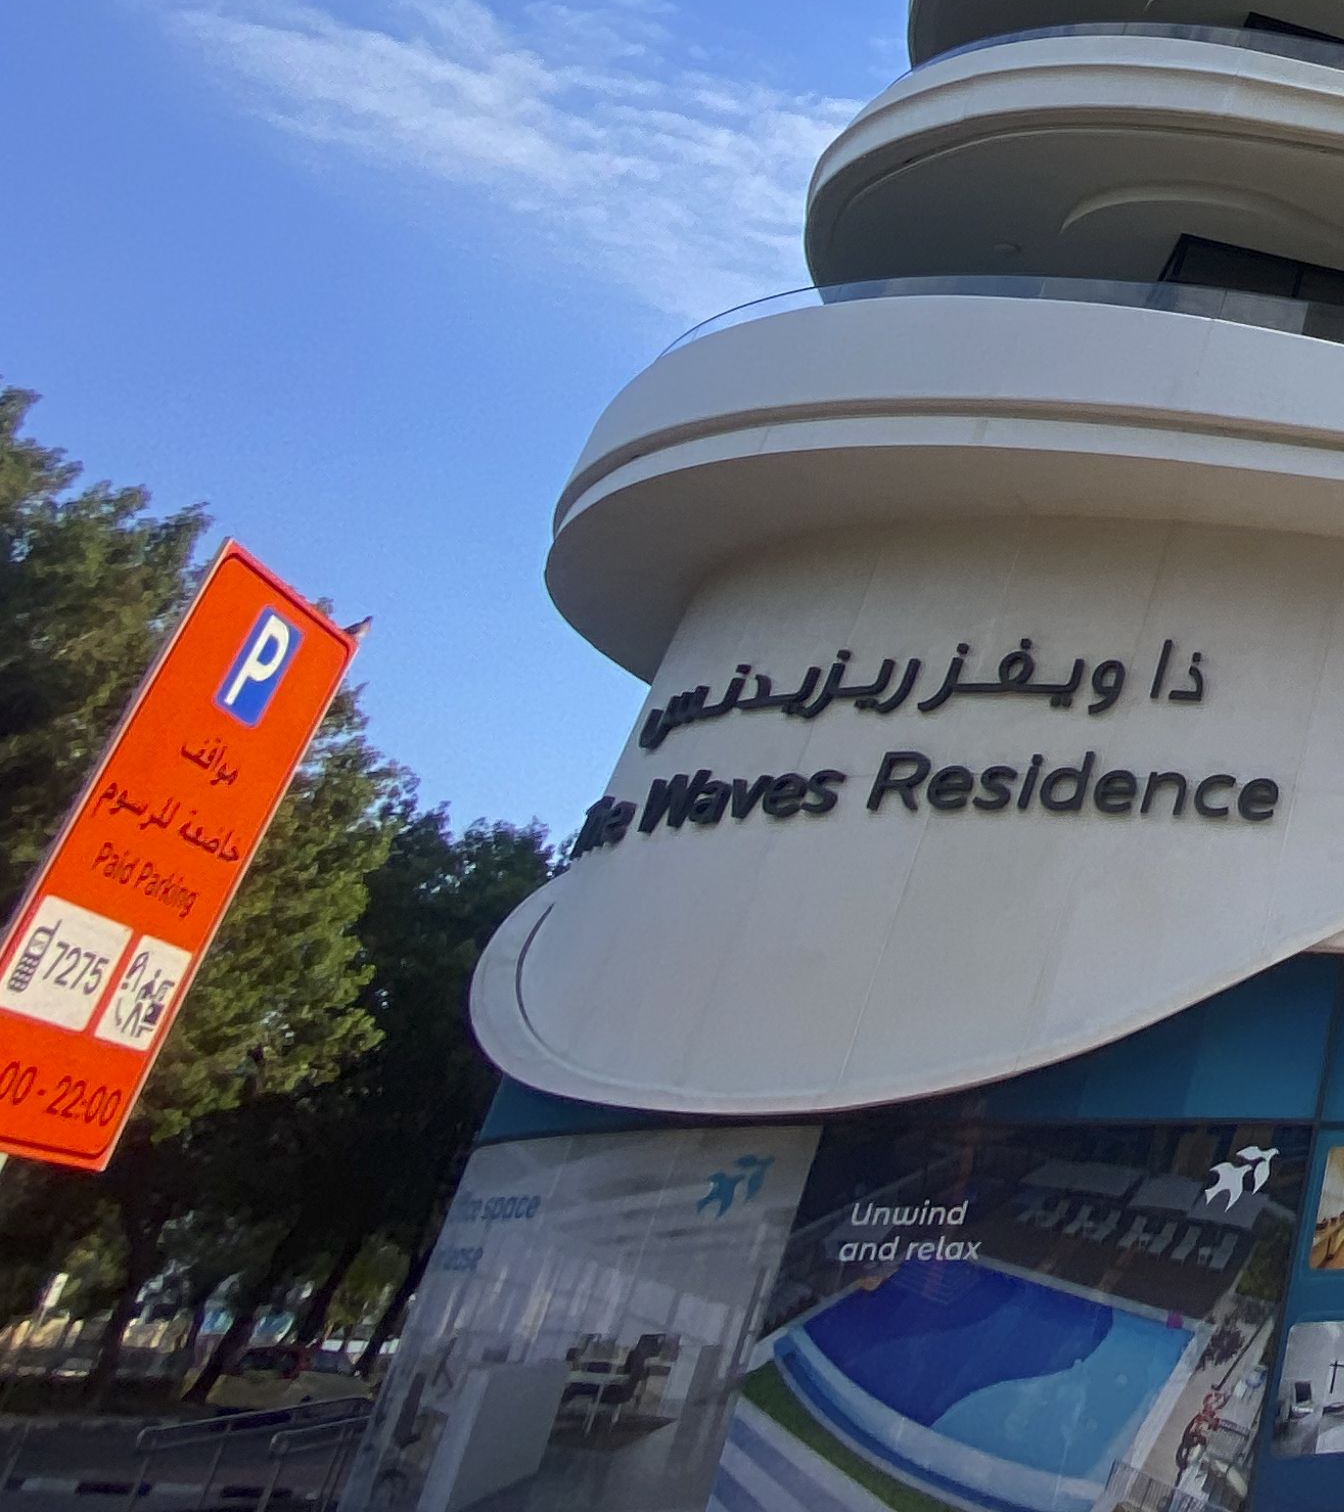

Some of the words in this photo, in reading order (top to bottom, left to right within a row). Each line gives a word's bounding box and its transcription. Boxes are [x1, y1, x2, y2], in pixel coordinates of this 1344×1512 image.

[224, 615, 290, 705] P
[918, 638, 1126, 715] ويفز
[1150, 639, 1204, 701] ذا
[639, 648, 922, 750] ريزيدنس
[180, 738, 239, 786] مواقف
[637, 769, 847, 834] Waves
[866, 751, 1279, 821] Residence
[91, 841, 140, 885] Paid
[134, 861, 198, 919] Parking
[43, 941, 110, 995] 7275
[46, 1075, 122, 1127] 22:00
[851, 1199, 969, 1226] Unwind
[838, 1236, 900, 1262] and
[905, 1236, 983, 1261] relax
